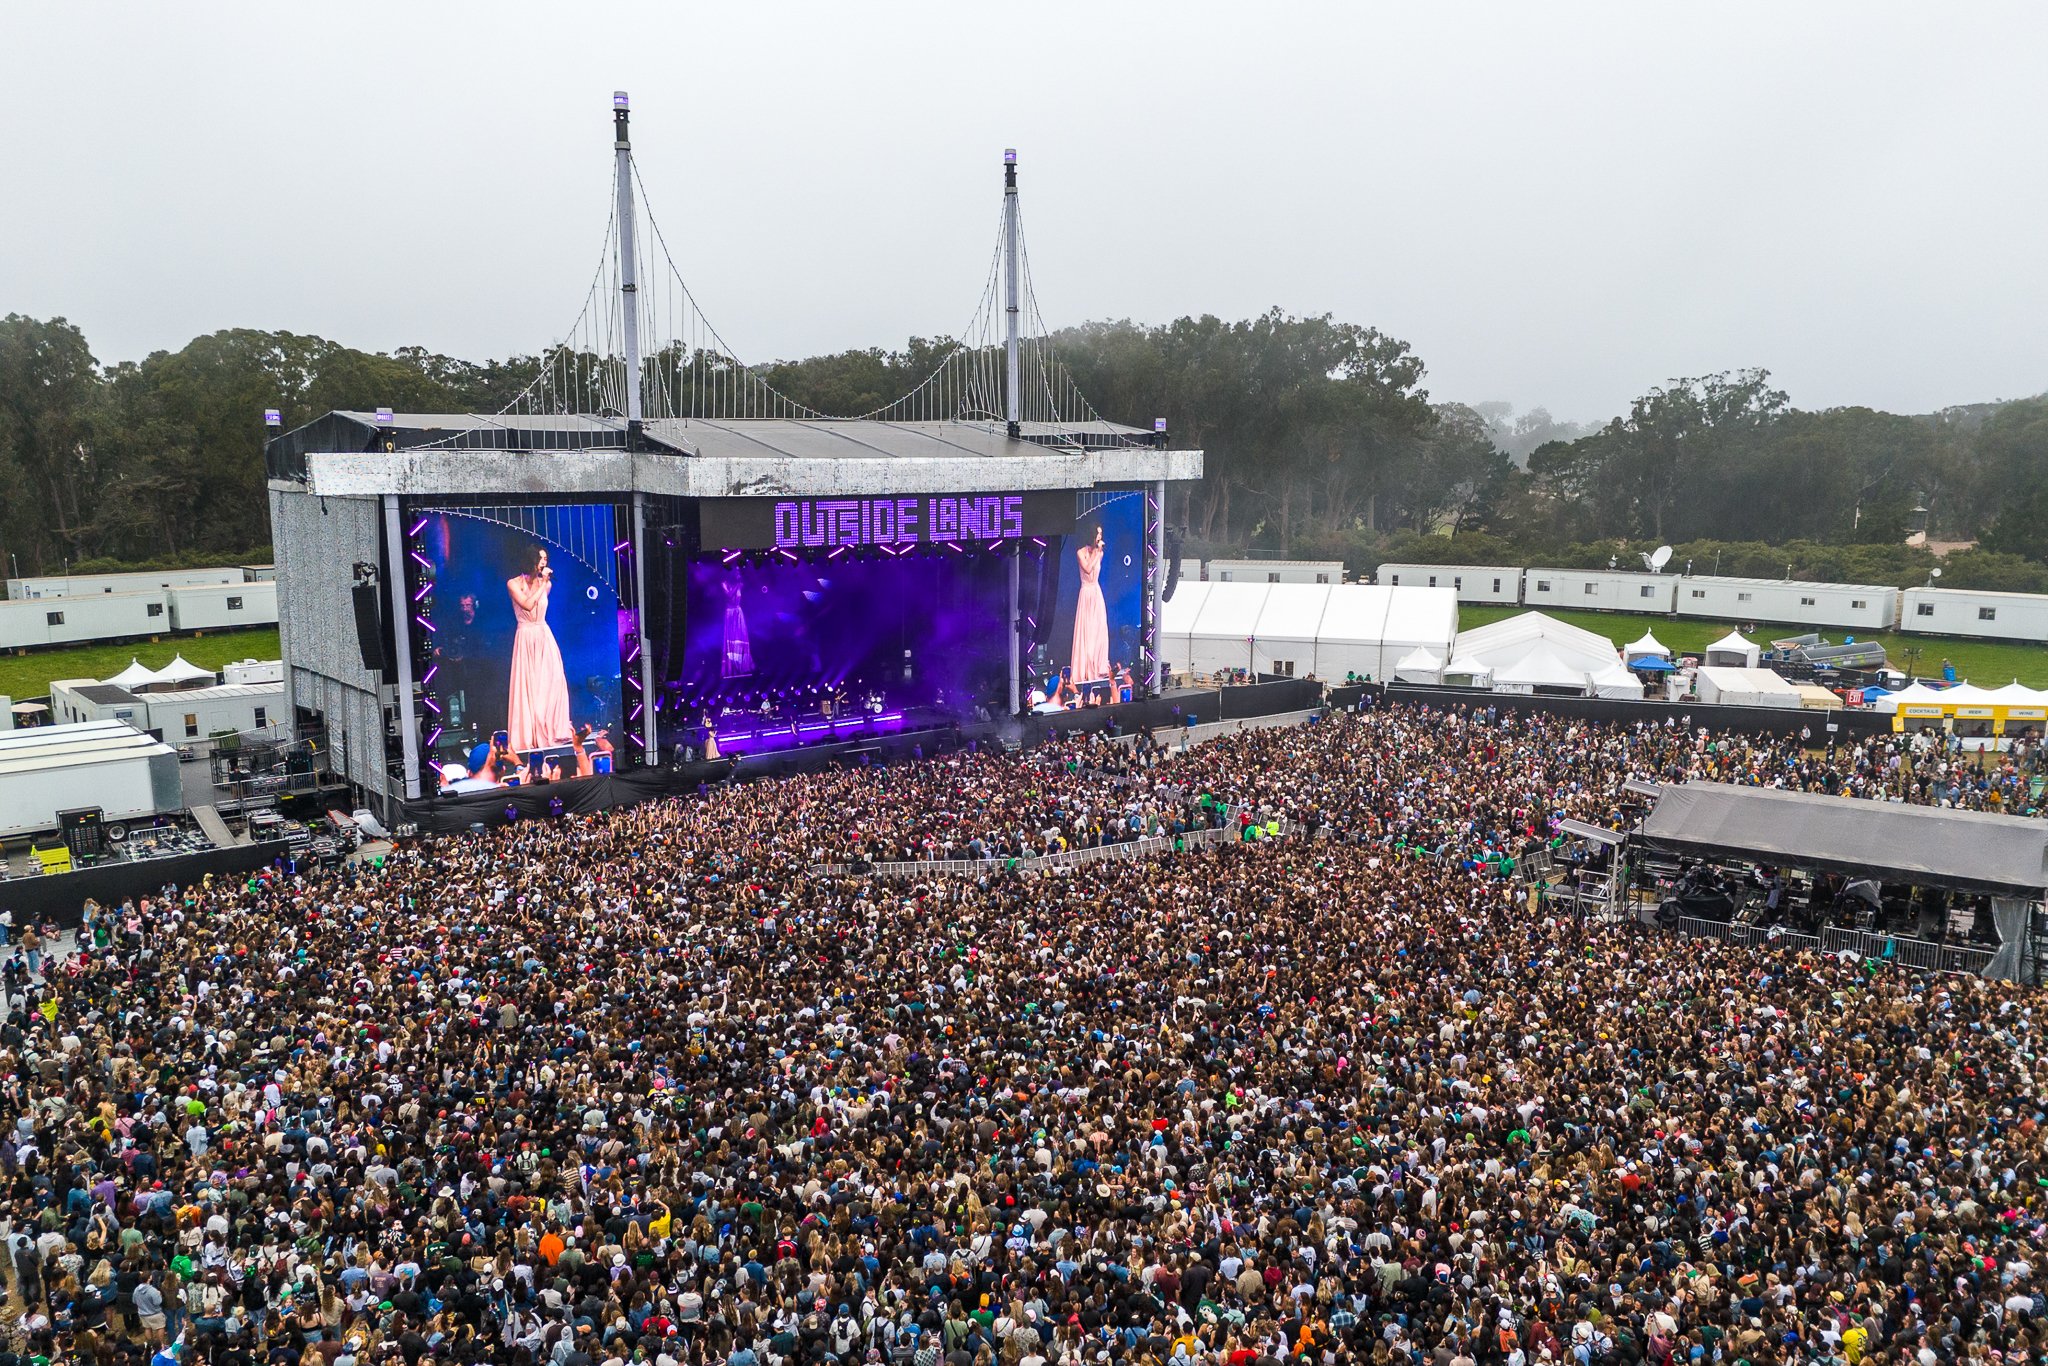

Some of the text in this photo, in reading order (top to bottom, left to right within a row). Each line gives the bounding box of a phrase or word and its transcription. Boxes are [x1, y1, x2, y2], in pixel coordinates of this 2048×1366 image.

[774, 496, 1023, 548] OUTSIDE LANDS
[1848, 693, 1862, 703] EXIT
